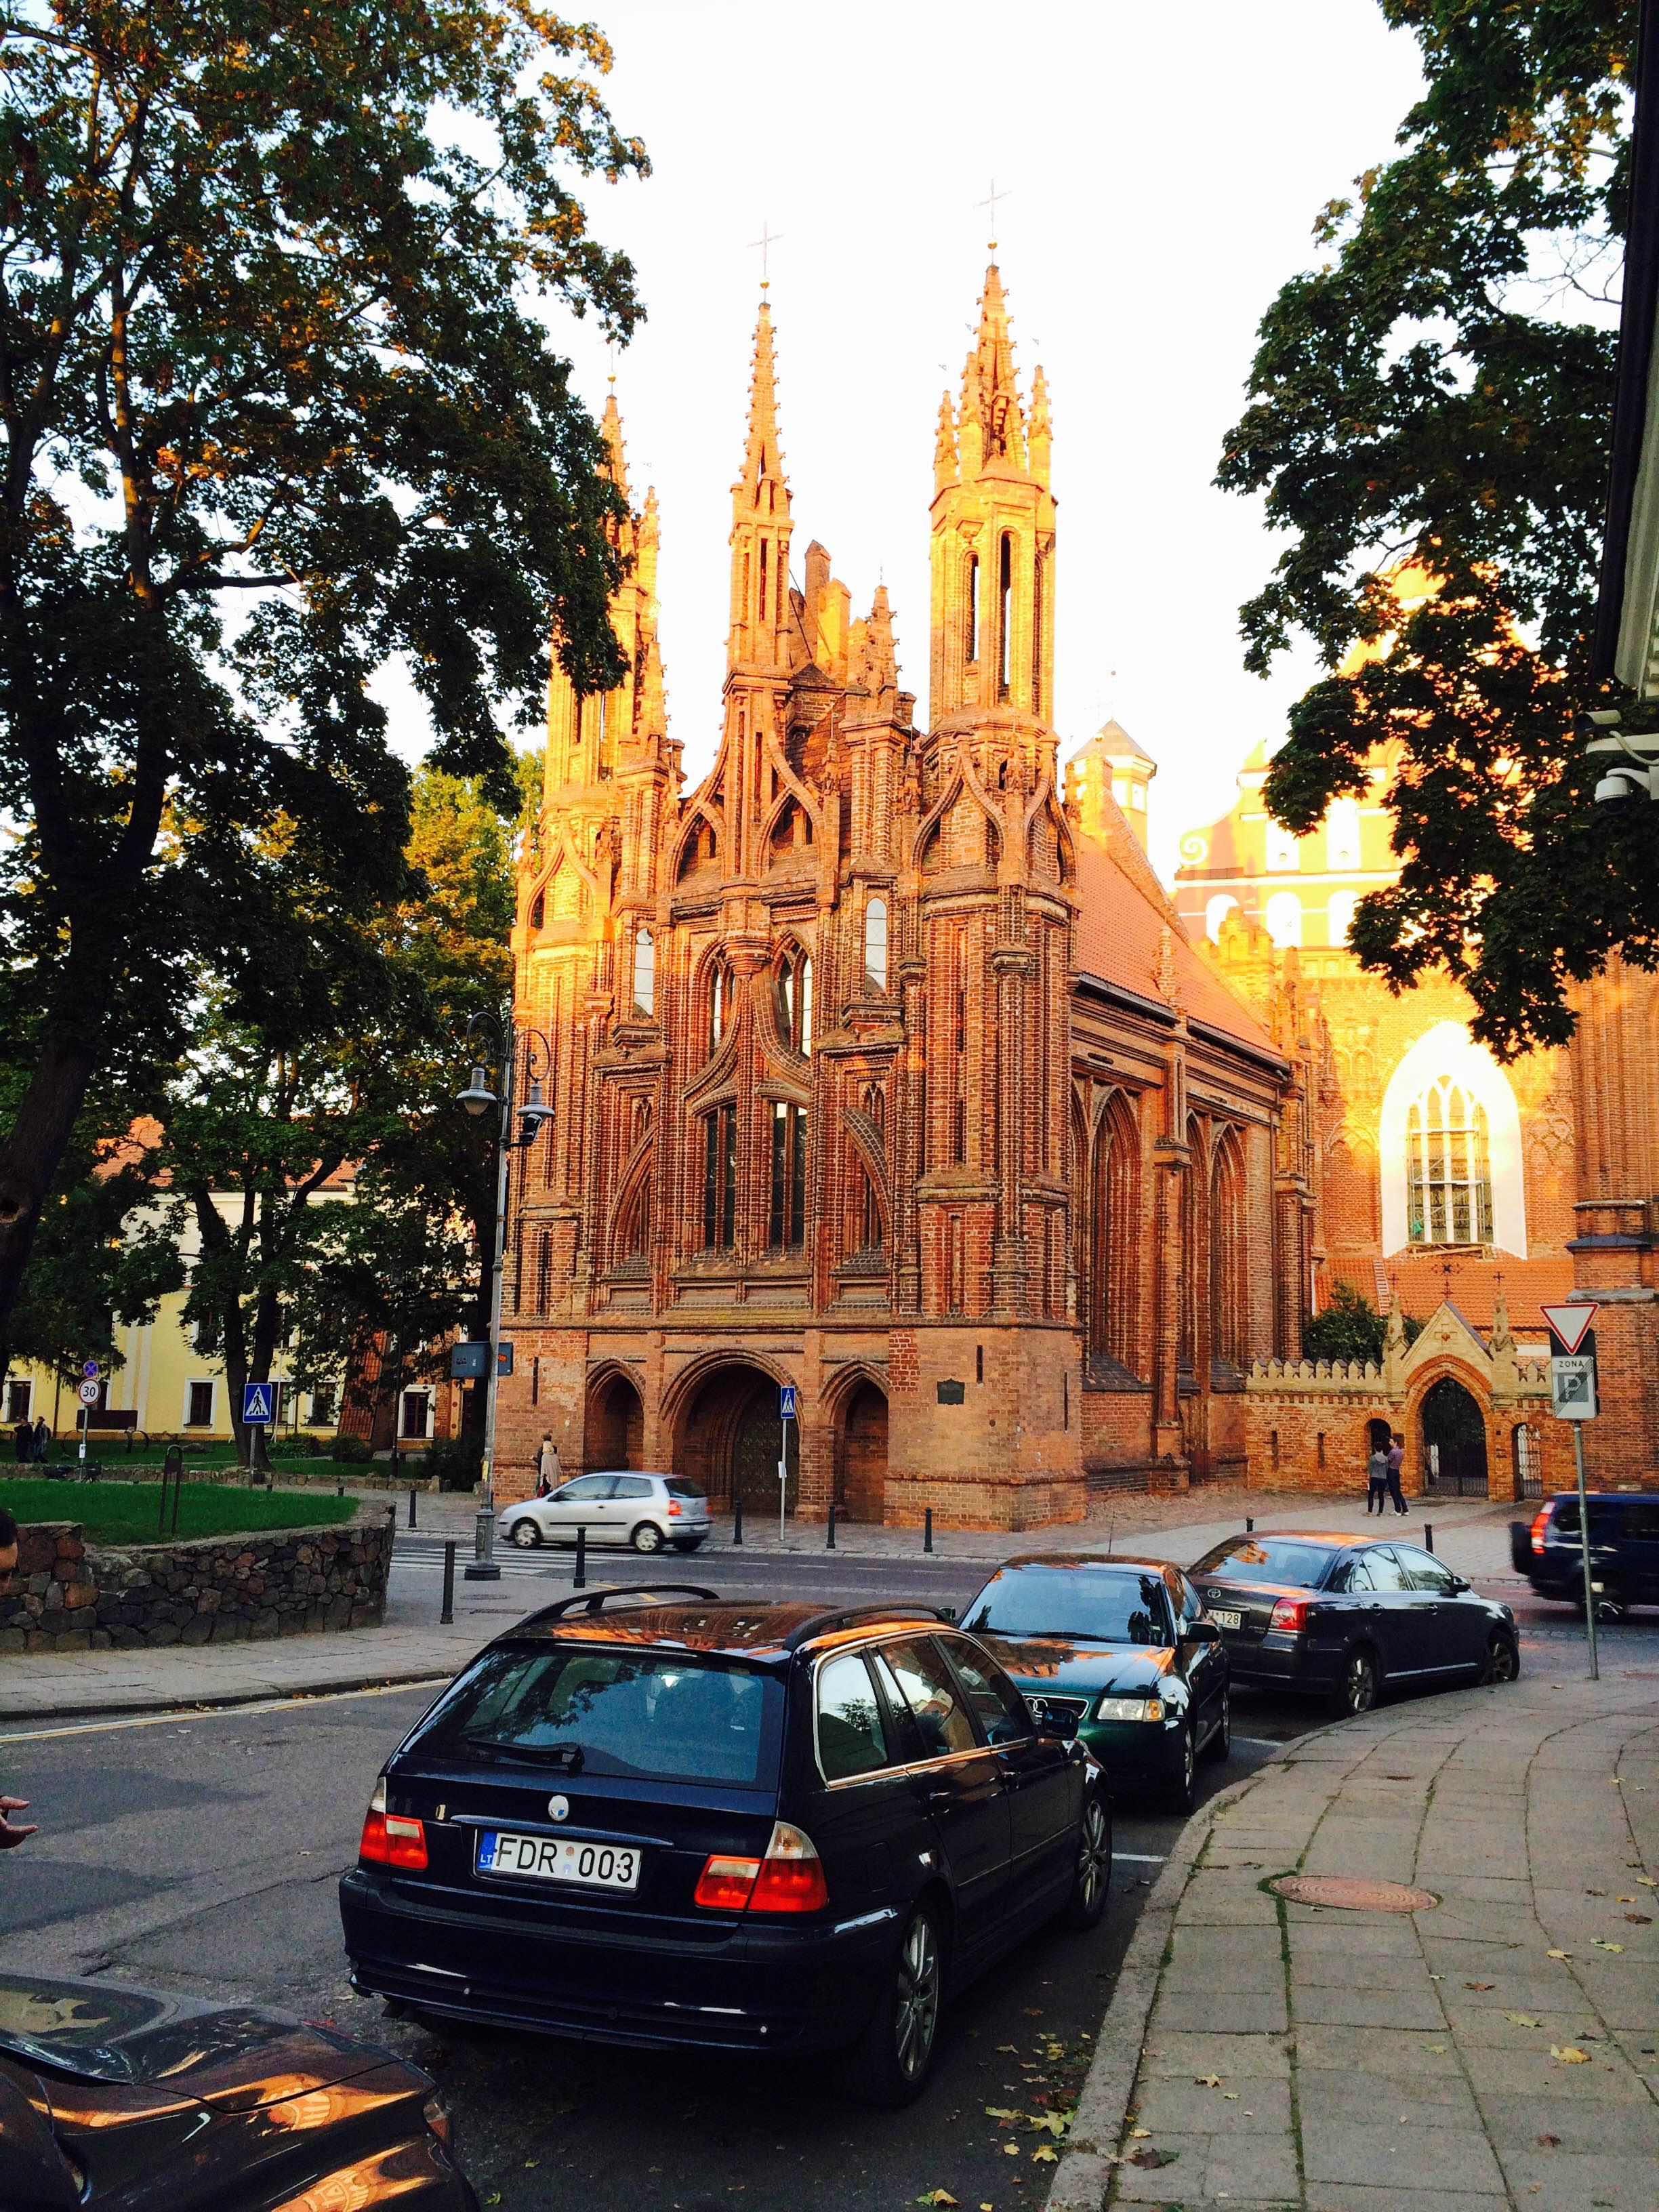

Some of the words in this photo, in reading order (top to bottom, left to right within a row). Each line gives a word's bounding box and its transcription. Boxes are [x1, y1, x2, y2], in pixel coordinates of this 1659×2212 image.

[83, 1386, 96, 1397] 30
[1222, 1612, 1239, 1624] 128
[480, 1854, 493, 1864] LT
[495, 1837, 558, 1873] FDR
[578, 1847, 634, 1883] 003
